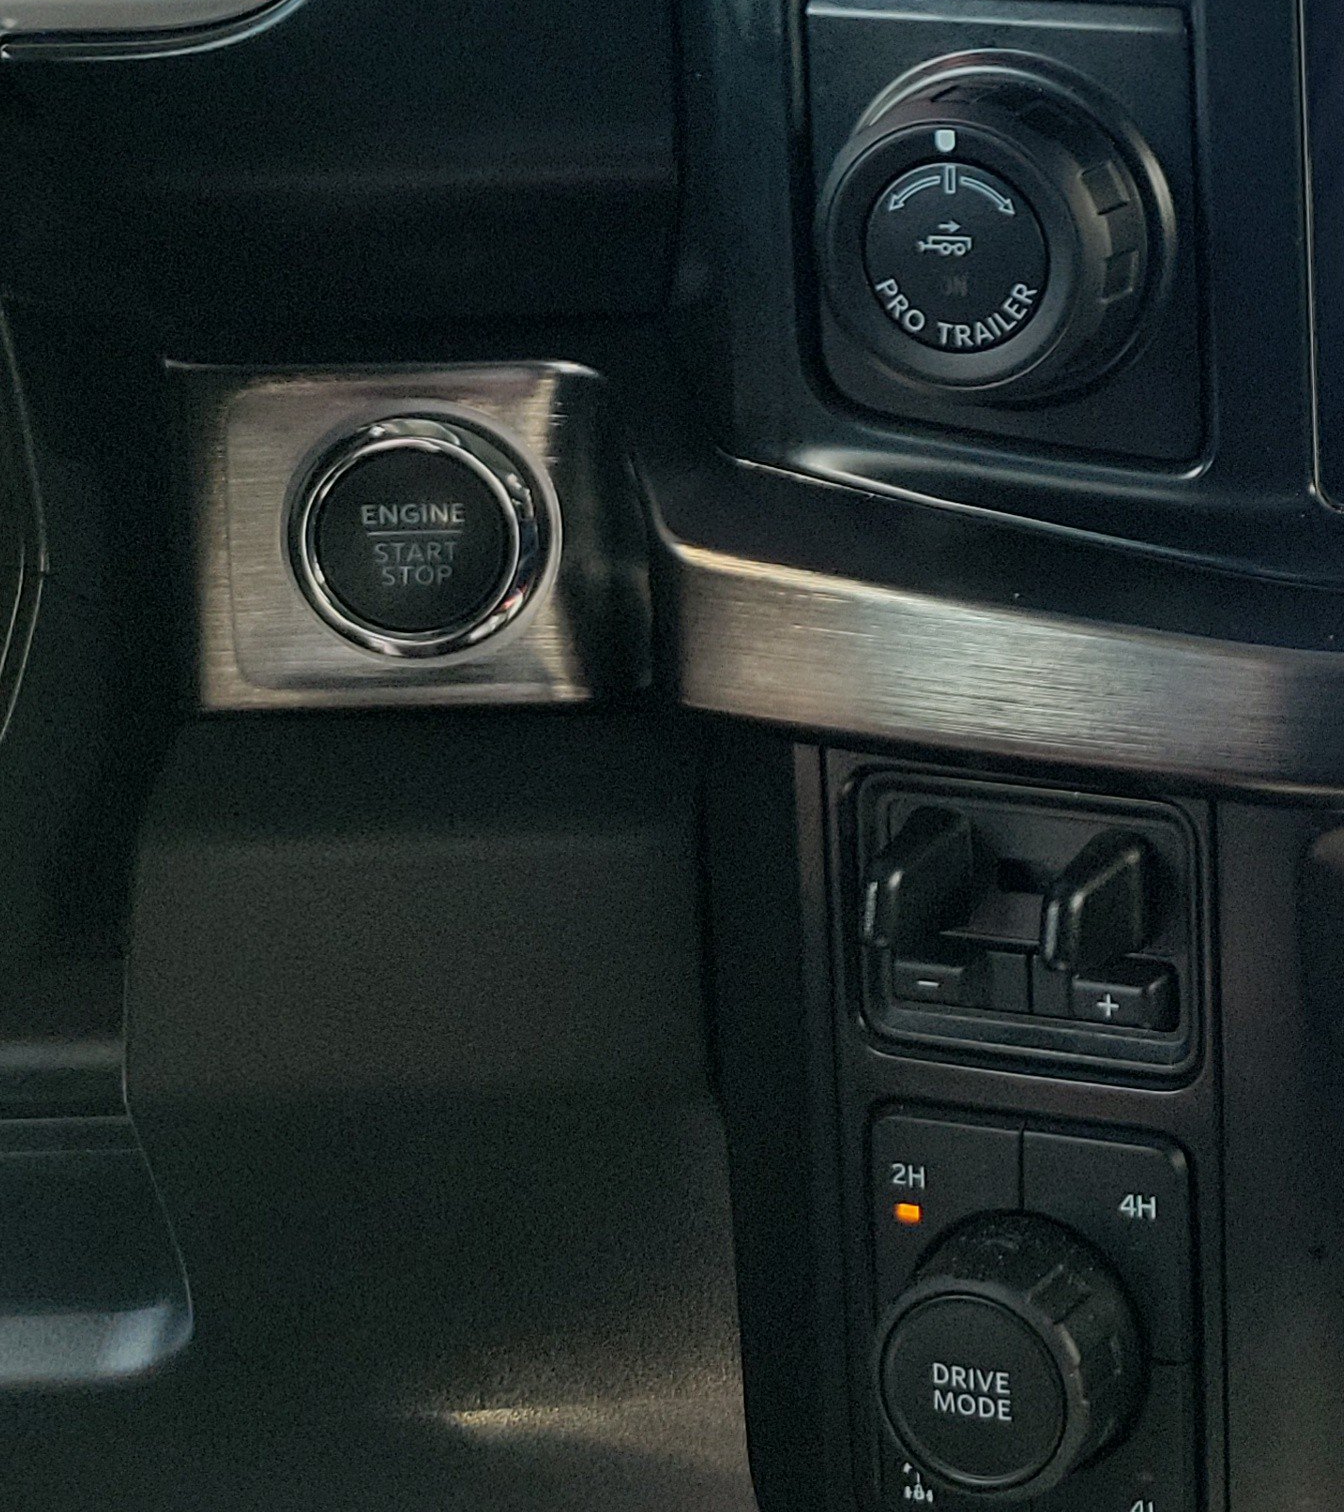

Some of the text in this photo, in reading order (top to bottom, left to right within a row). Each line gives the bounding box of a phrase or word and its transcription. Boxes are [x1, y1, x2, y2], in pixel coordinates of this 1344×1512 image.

[876, 278, 926, 332] PRO
[937, 282, 1038, 347] TRAILER
[361, 503, 466, 526] ENGINE
[374, 541, 458, 564] START
[382, 565, 453, 586] STOP
[891, 1162, 926, 1189] 2H
[1119, 1194, 1158, 1220] 4H
[932, 1362, 1011, 1396] DRIVE
[932, 1389, 1012, 1421] MODE
